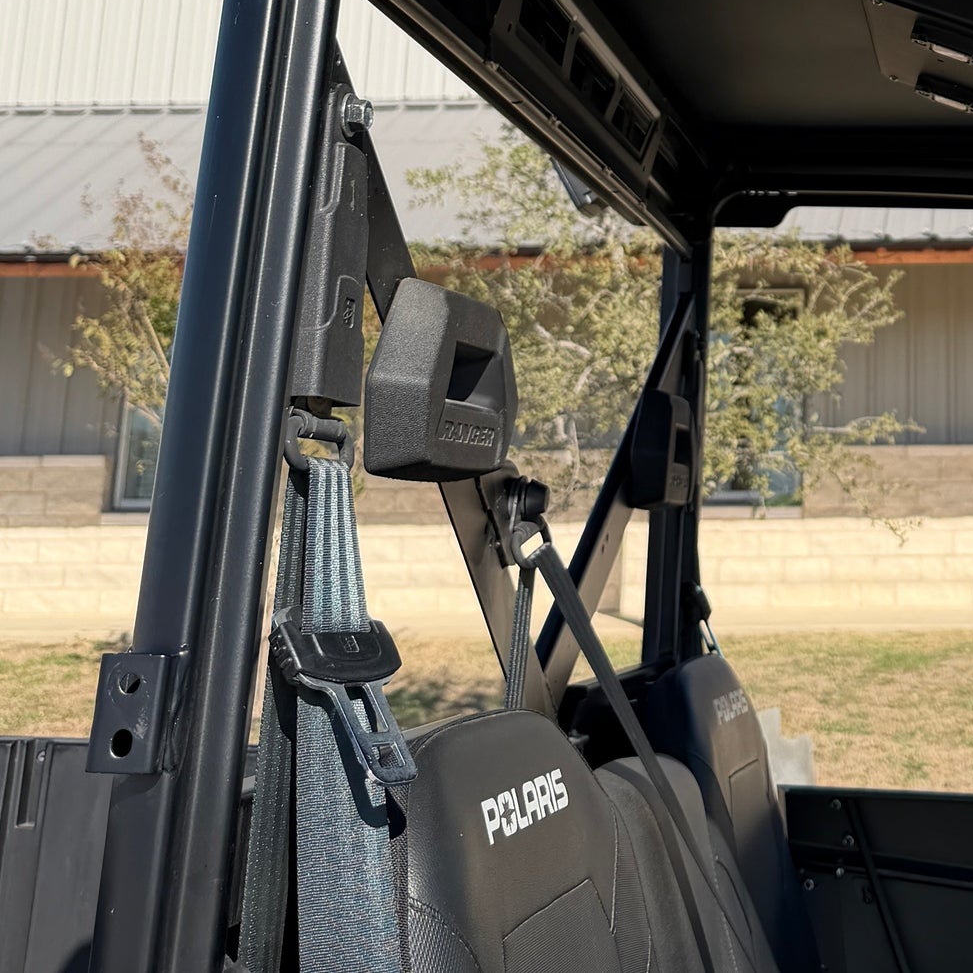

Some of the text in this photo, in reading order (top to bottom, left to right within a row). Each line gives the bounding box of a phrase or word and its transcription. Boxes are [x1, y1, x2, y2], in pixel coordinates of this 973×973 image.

[438, 420, 496, 447] RANGER
[712, 688, 749, 725] POLARIS
[481, 768, 569, 845] POLARIS
